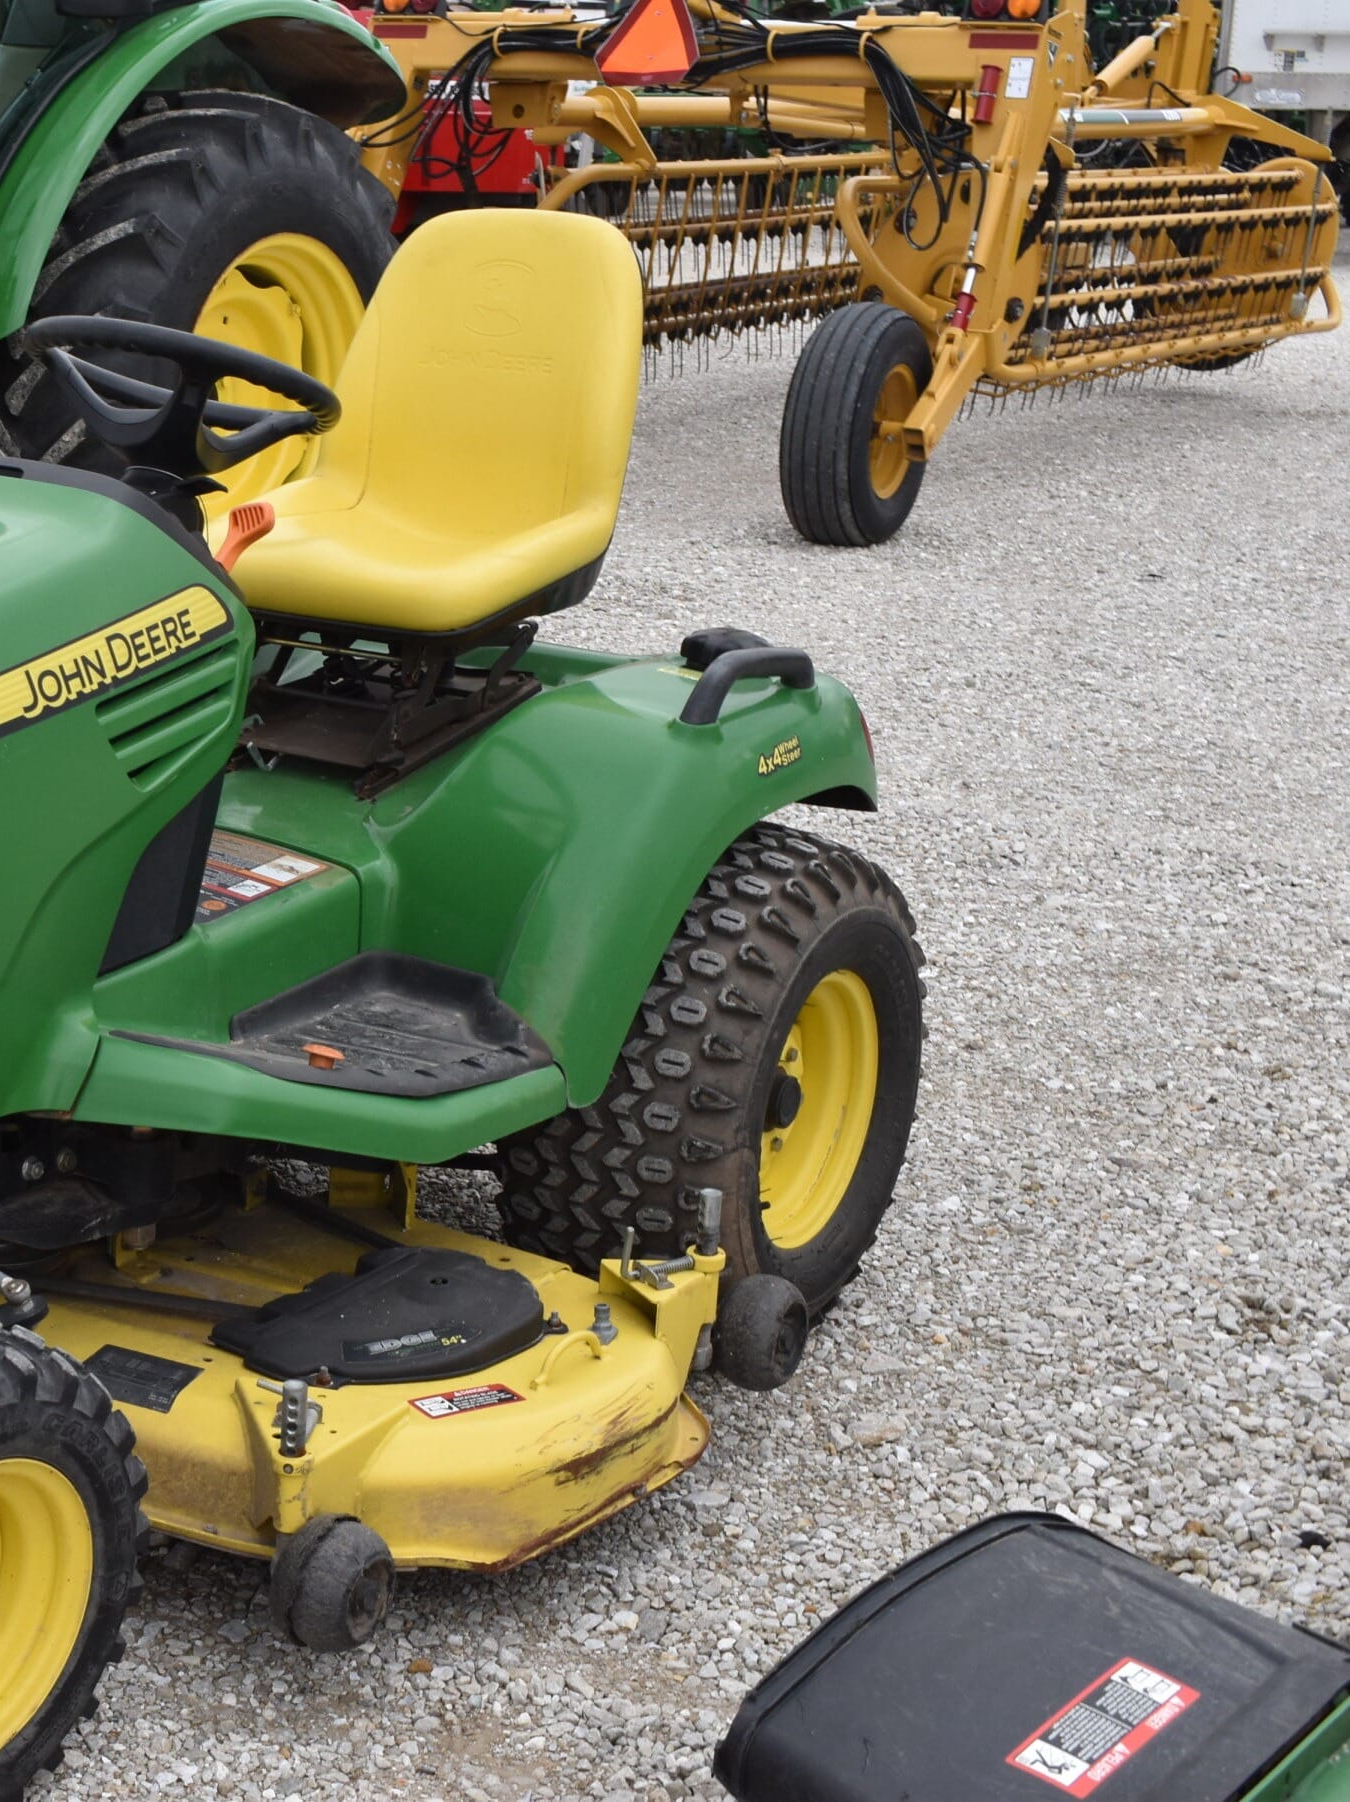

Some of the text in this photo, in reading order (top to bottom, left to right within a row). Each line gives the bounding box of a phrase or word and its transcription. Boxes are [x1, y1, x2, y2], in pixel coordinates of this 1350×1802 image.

[22, 607, 198, 714] JOHN DEERE
[364, 1329, 438, 1356] EDGE
